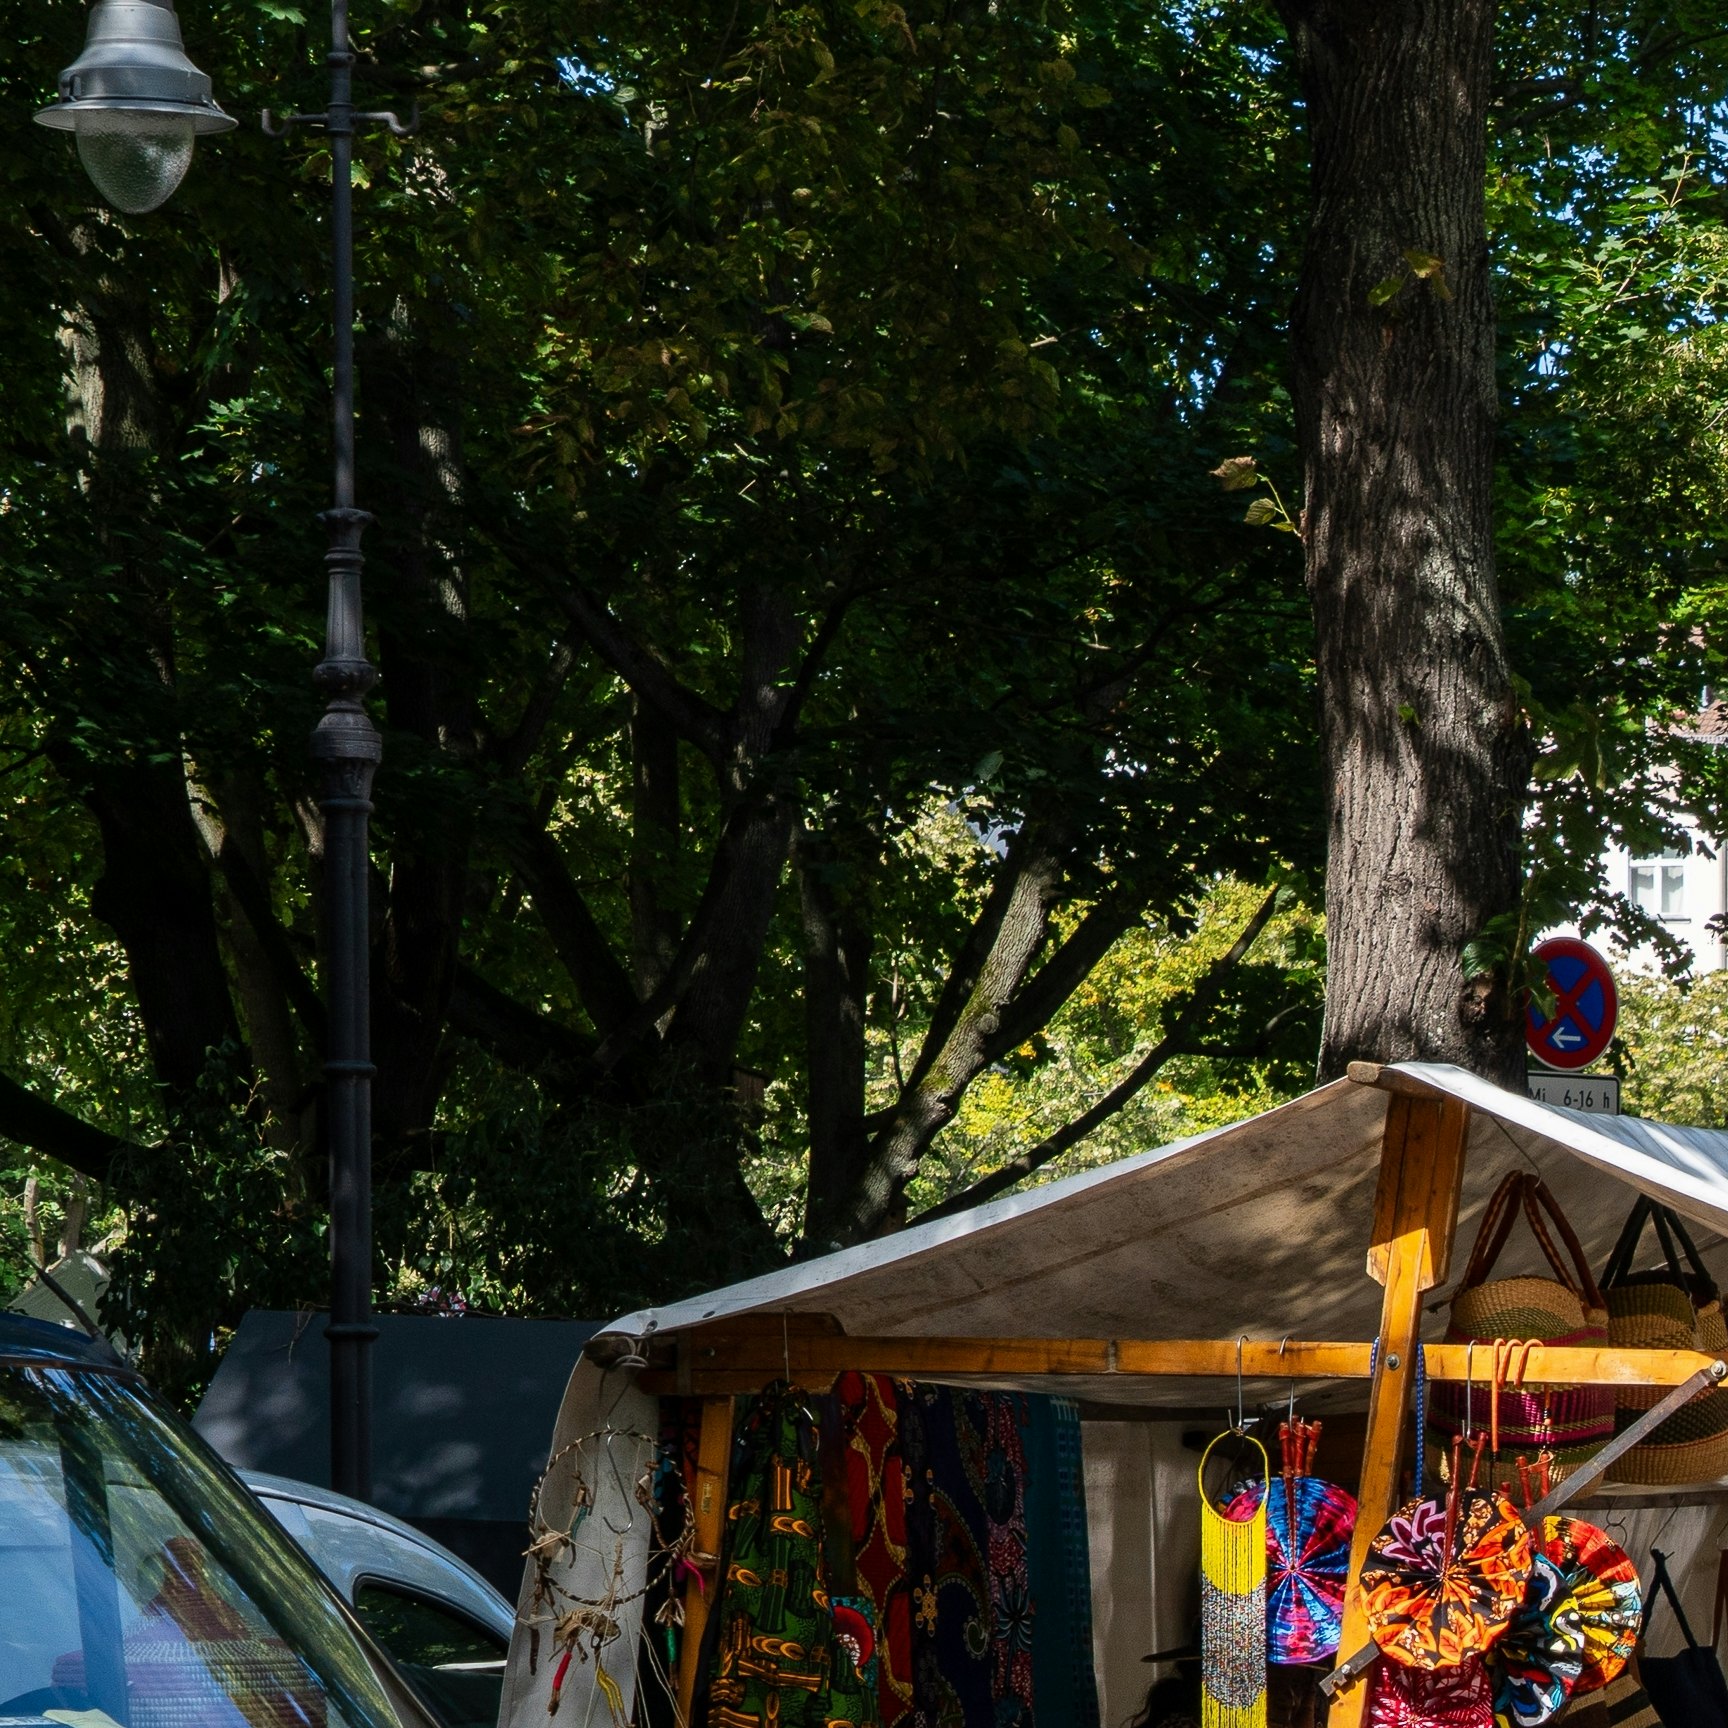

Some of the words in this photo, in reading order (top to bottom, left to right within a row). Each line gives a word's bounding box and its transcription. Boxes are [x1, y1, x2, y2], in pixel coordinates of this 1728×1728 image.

[1528, 1088, 1546, 1102] Mi
[1563, 1089, 1594, 1108] 6-16
[1603, 1091, 1610, 1109] h
